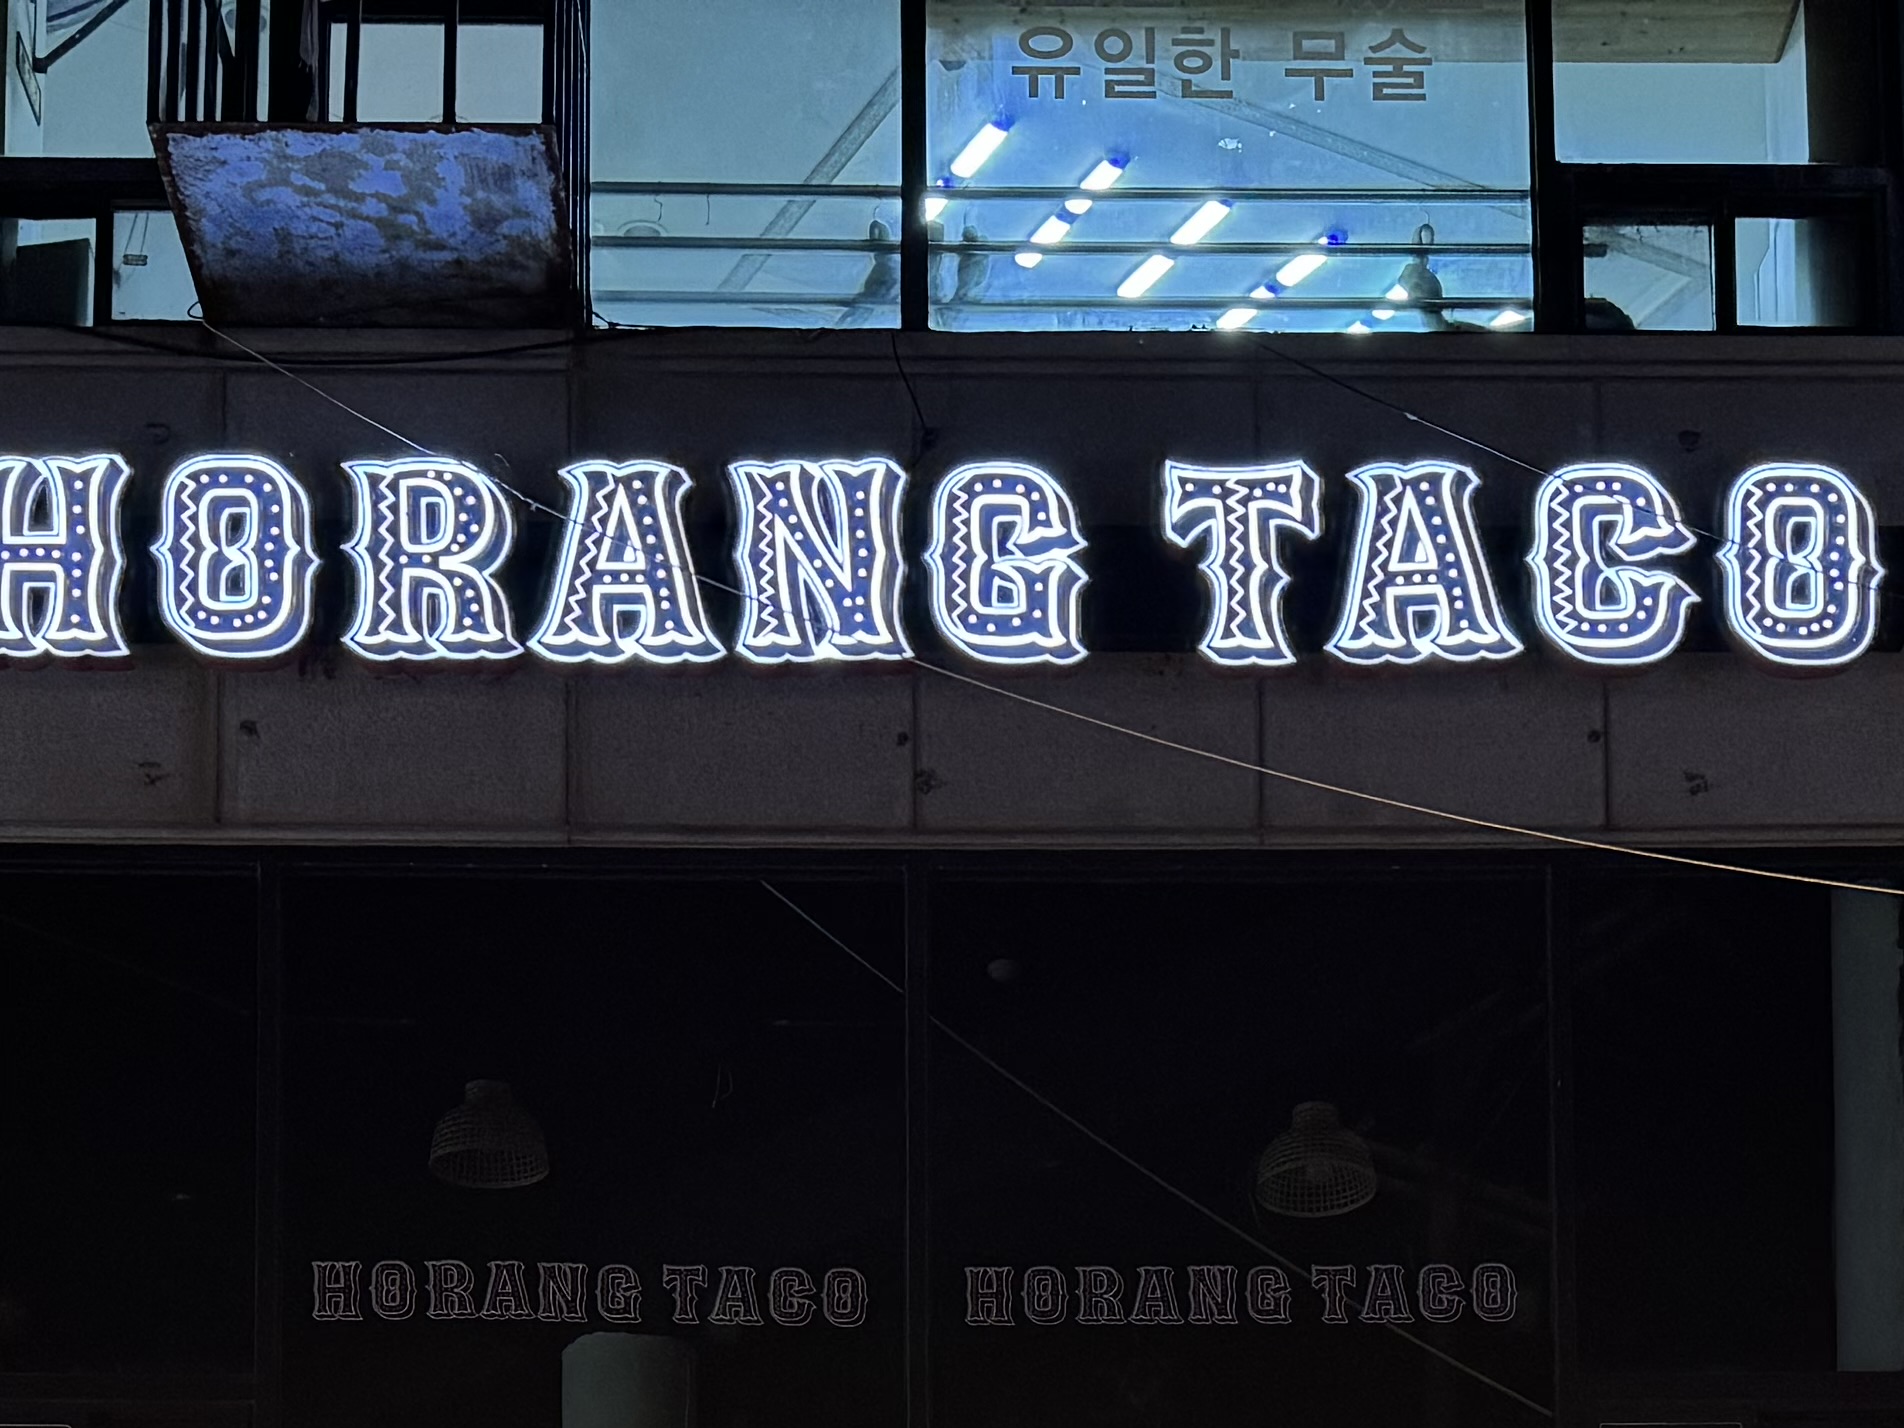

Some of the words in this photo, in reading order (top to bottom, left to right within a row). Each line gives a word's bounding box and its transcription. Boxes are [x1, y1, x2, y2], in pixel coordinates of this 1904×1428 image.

[1010, 24, 1240, 101] 유일한
[1283, 27, 1435, 103] 무술
[1162, 457, 1885, 666] TACO
[310, 1257, 642, 1325] HORANG
[661, 1262, 870, 1328] TACO
[963, 1264, 1293, 1326] HORANG
[1311, 1261, 1520, 1326] TACO
